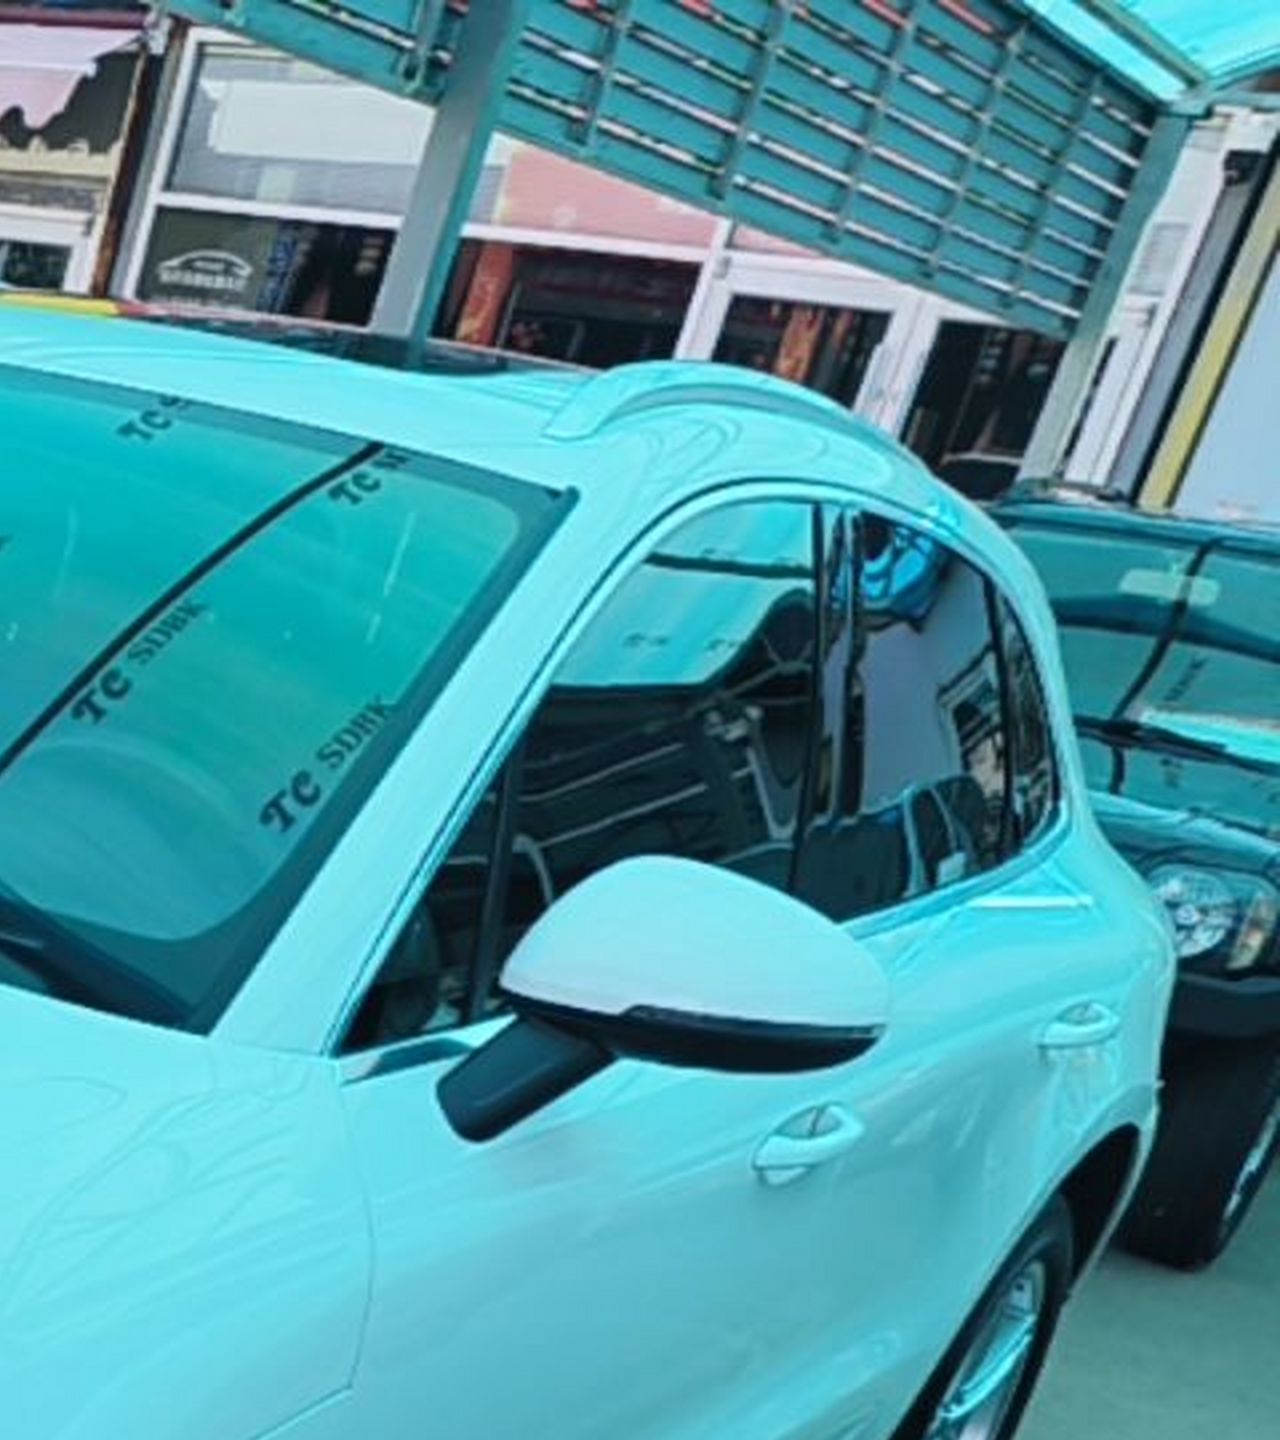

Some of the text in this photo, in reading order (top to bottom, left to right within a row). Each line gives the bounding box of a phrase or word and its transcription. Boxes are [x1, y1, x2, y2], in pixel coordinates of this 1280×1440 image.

[327, 469, 382, 506] TC
[70, 602, 209, 725] TC SDBK
[258, 694, 396, 833] TC SDBK
